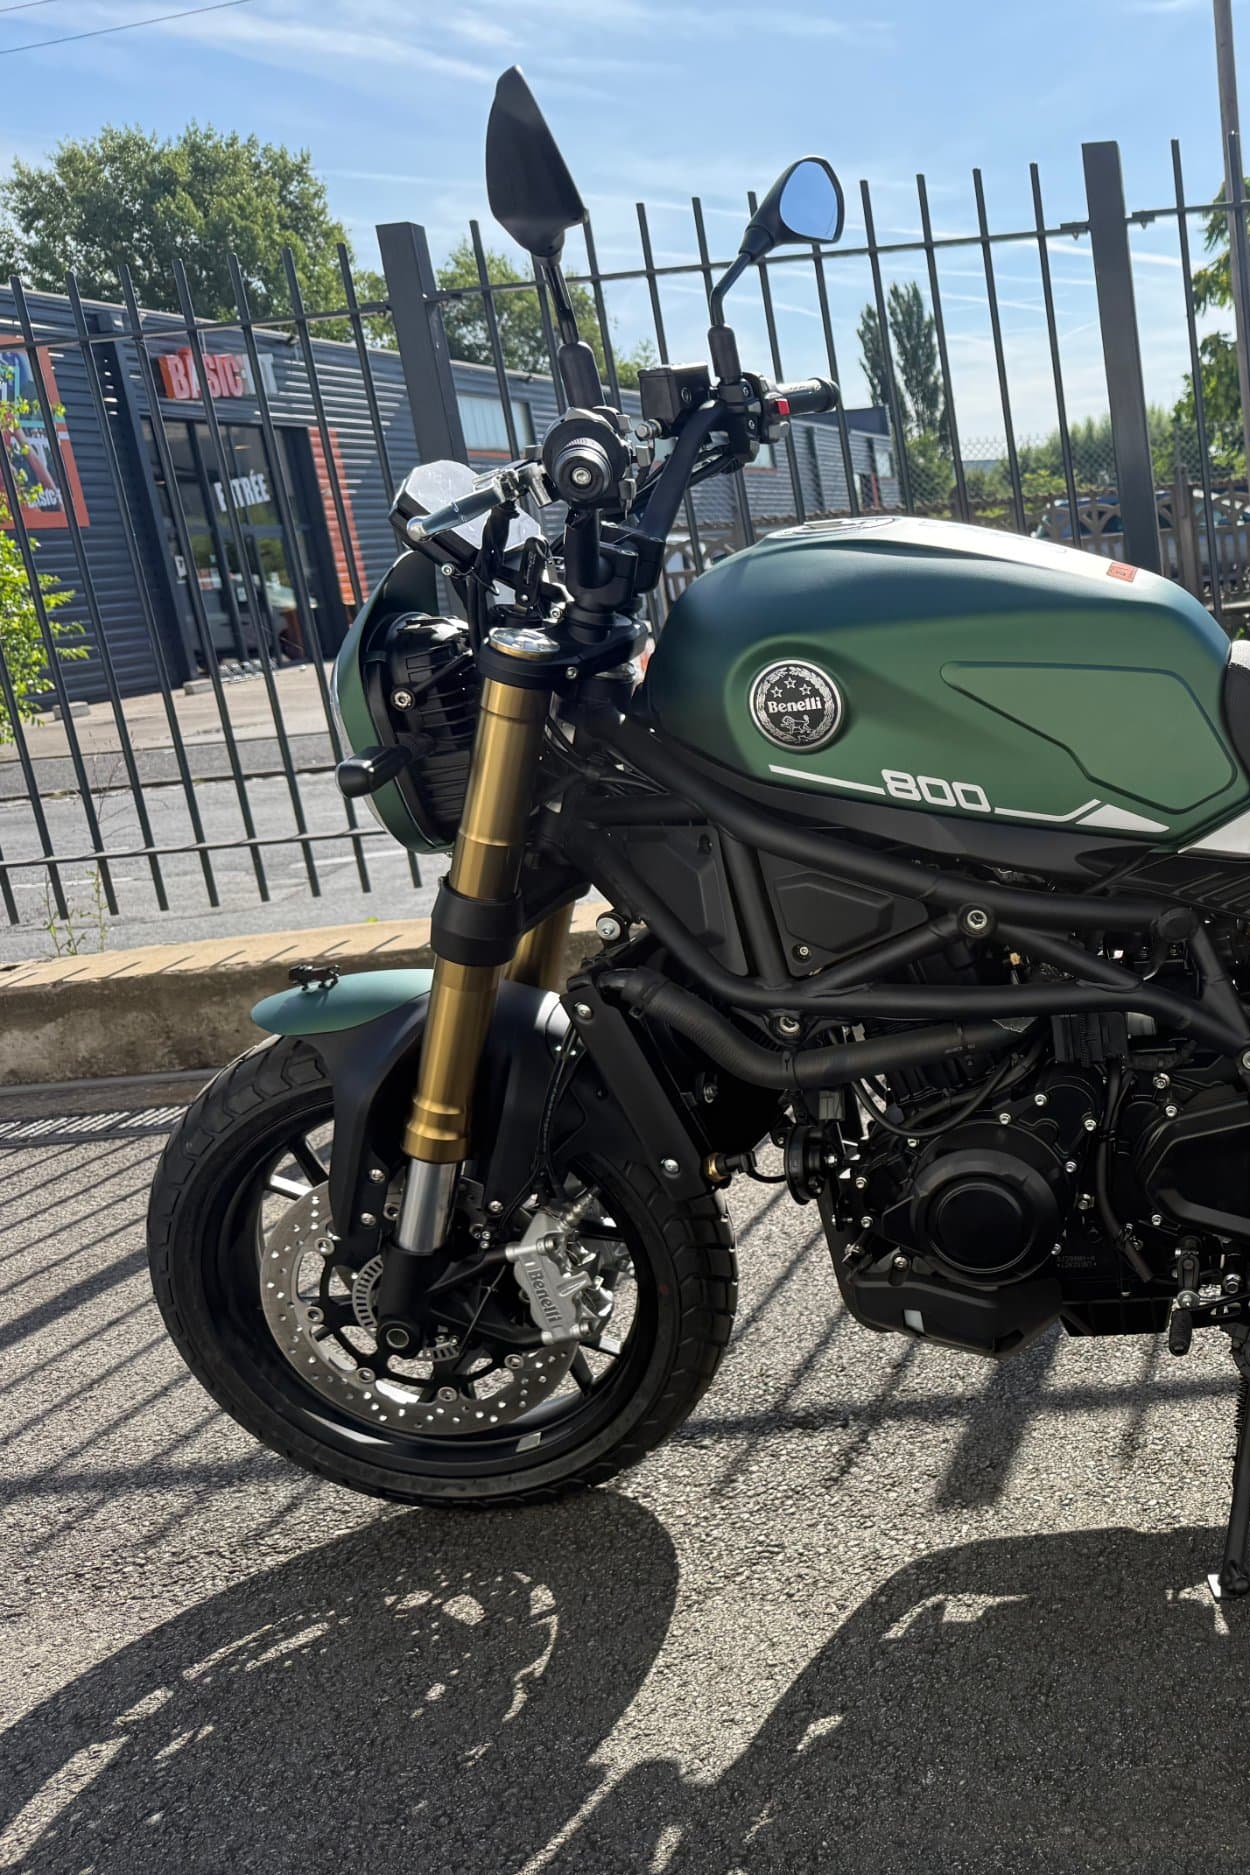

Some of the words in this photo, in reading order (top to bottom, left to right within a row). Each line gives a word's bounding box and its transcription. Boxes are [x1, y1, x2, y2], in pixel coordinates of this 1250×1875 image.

[214, 469, 271, 512] ETRÉE
[767, 697, 822, 713] Benelli
[881, 769, 991, 812] 800
[527, 1271, 562, 1323] Benelli
